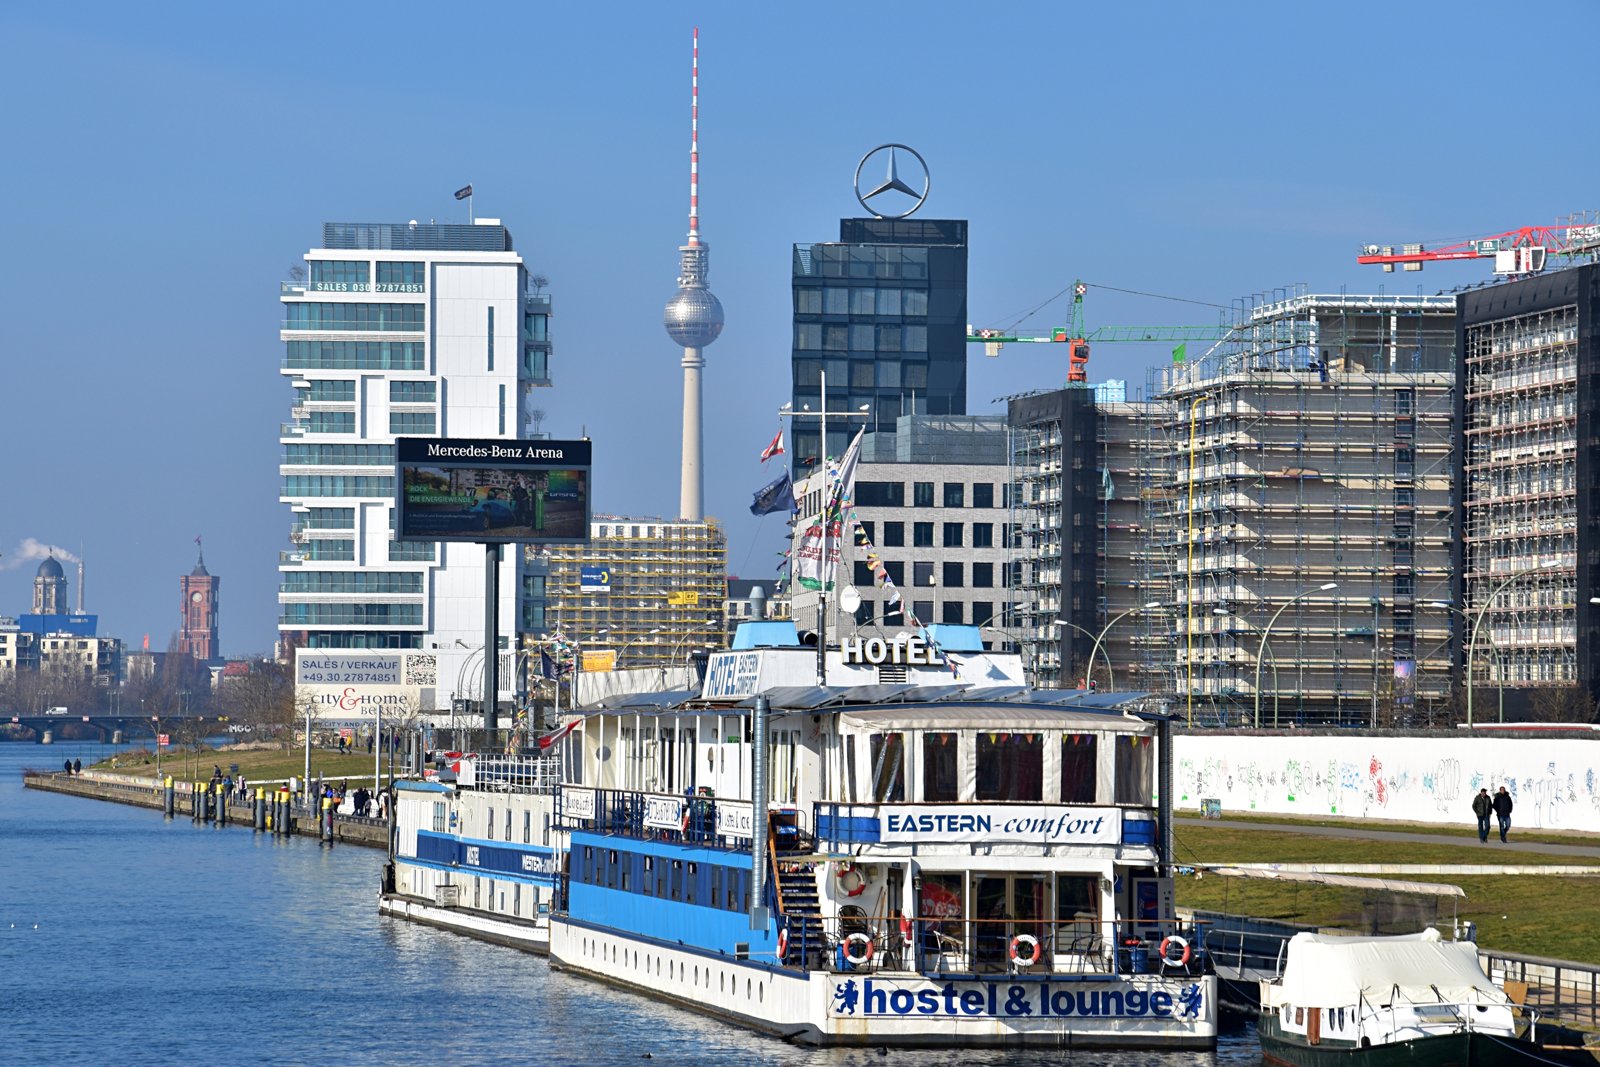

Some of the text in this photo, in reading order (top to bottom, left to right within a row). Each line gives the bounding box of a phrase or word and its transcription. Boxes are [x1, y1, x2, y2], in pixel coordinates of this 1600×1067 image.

[317, 283, 423, 292] SALES 030 27874851
[427, 443, 564, 459] Mercedes-Benz Arena
[841, 637, 944, 664] HOTEL
[302, 660, 338, 669] SALES
[347, 661, 398, 669] VERKAUF
[303, 673, 397, 682] +49.30.27874851
[707, 655, 737, 697] HOTEL
[863, 979, 1174, 1016] hostel & lounge
